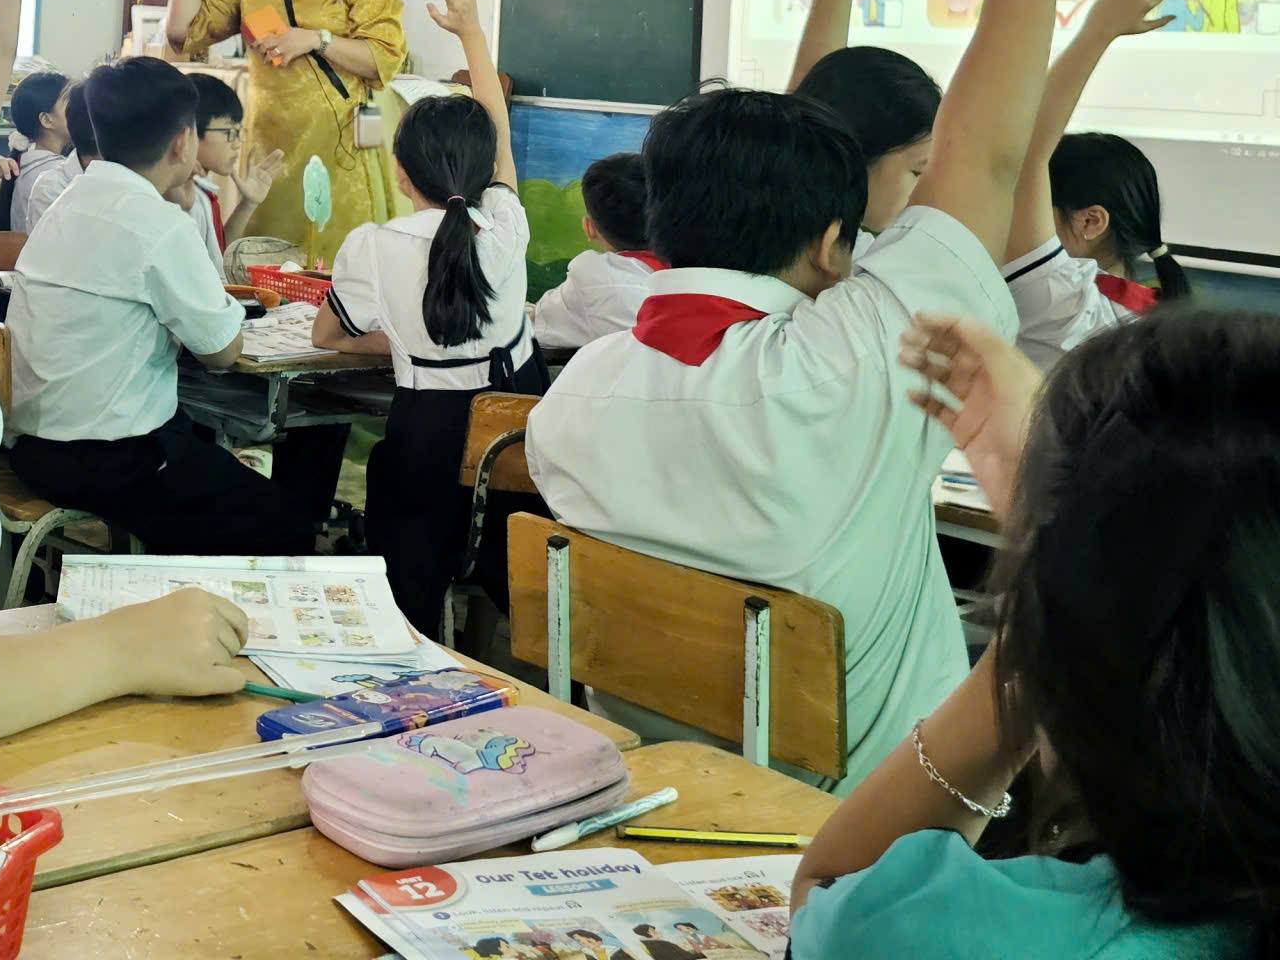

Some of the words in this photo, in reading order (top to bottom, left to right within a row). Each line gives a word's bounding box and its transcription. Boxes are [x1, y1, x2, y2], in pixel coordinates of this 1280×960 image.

[475, 873, 514, 884] Our
[518, 869, 555, 882] Tet
[560, 862, 641, 882] holiday
[399, 880, 446, 901] 12
